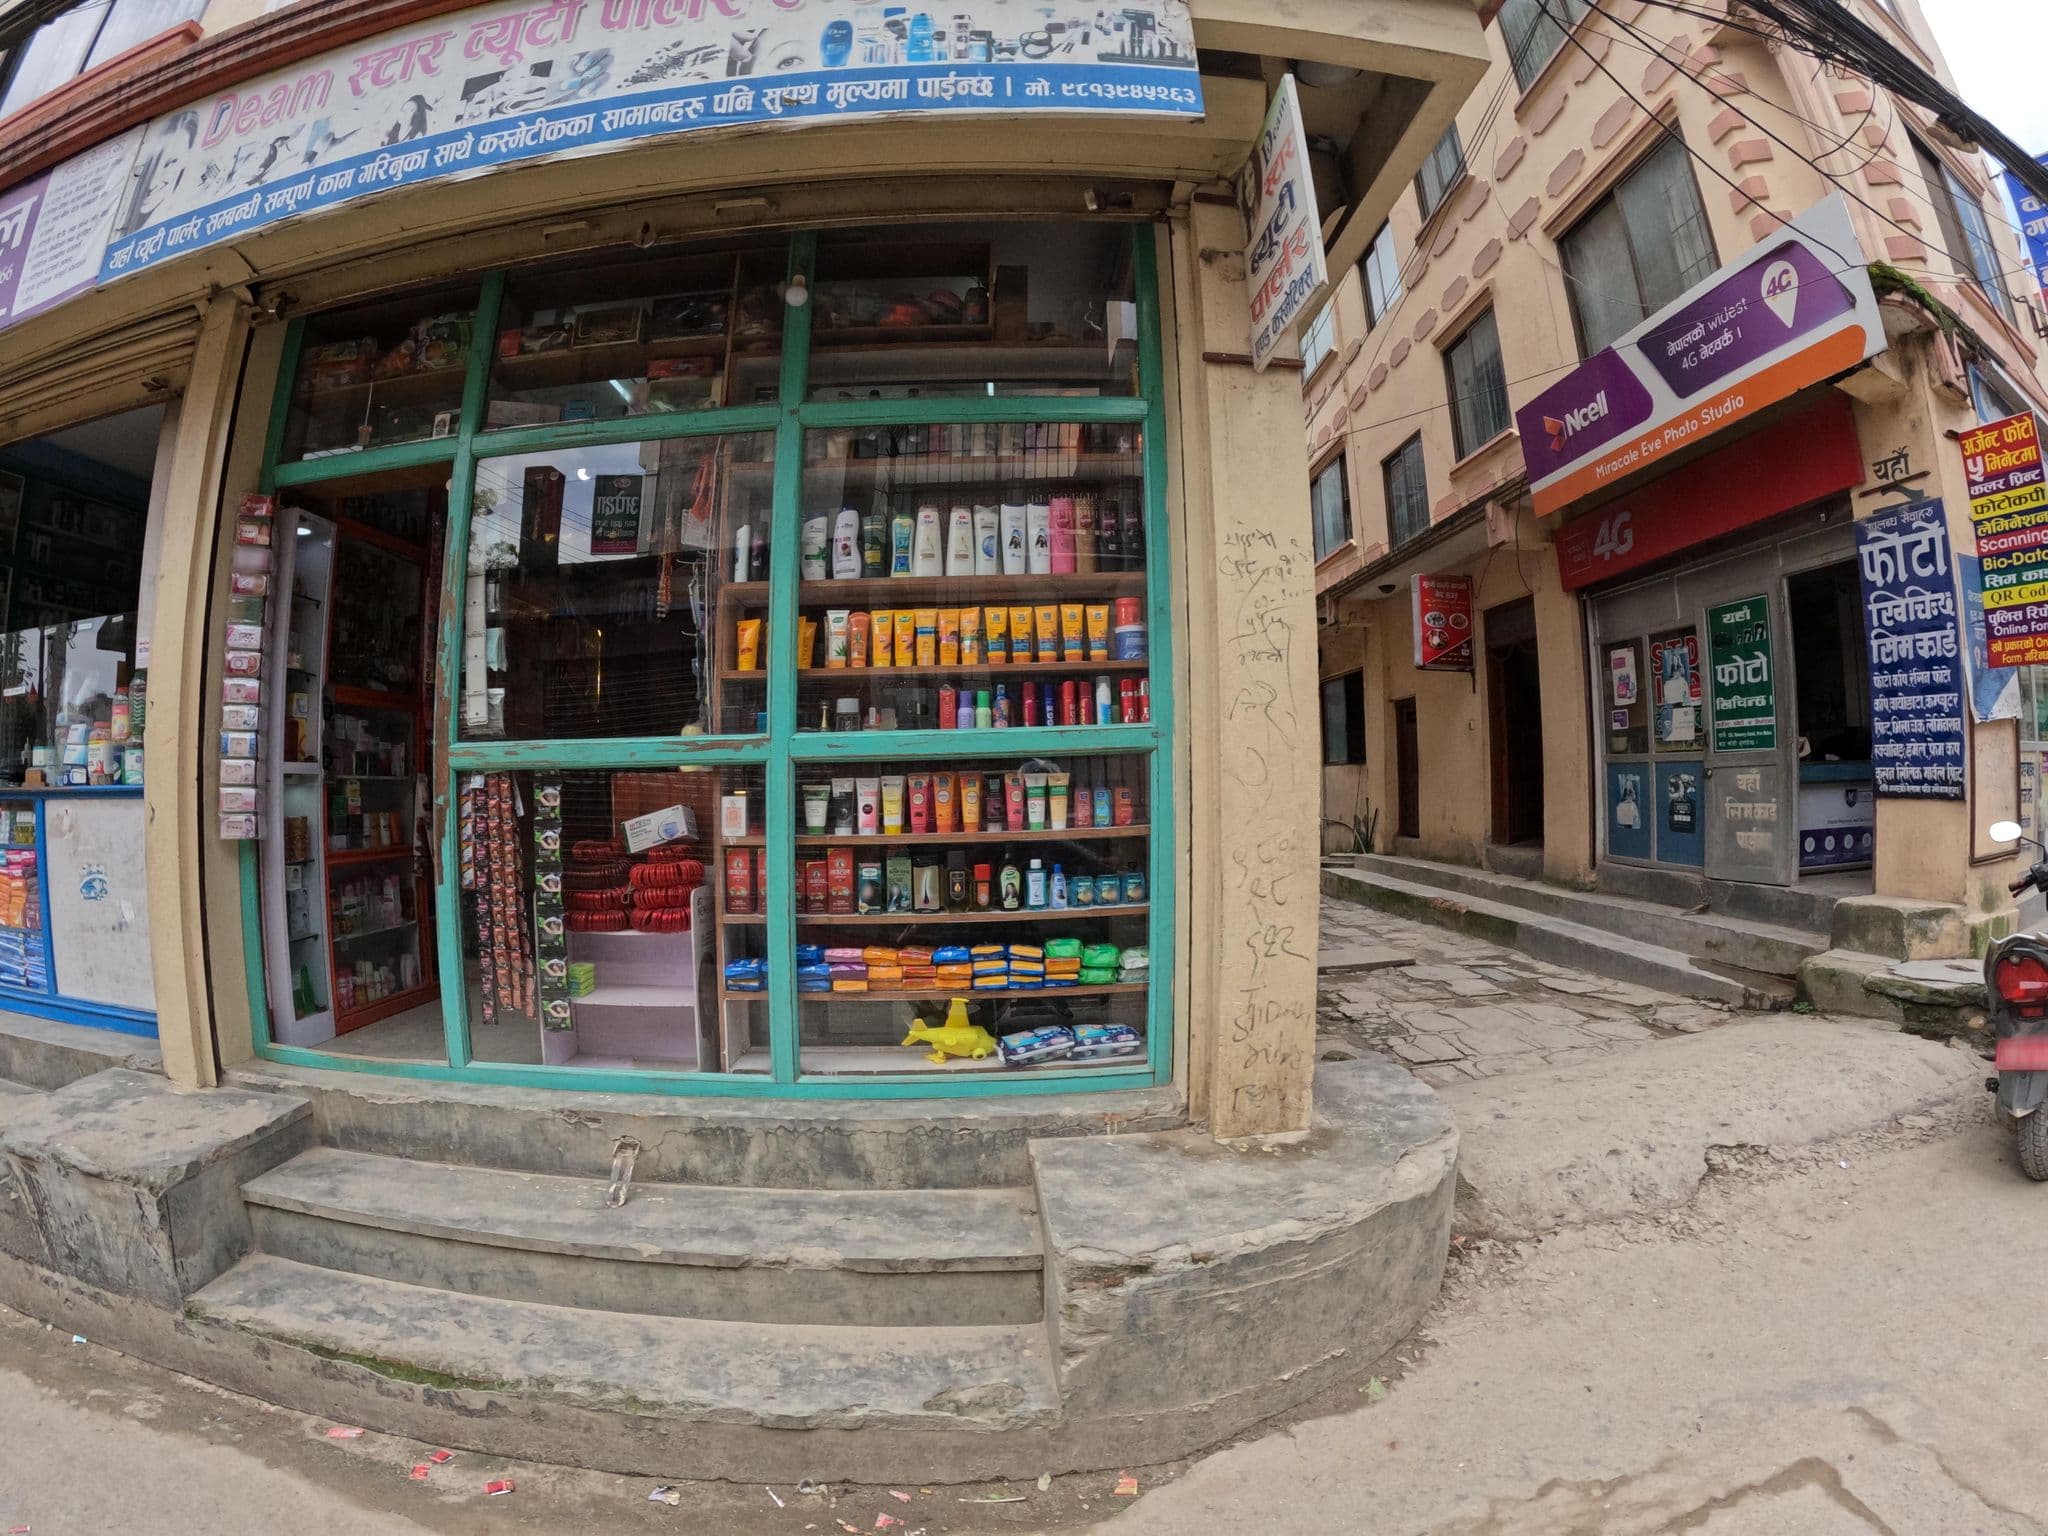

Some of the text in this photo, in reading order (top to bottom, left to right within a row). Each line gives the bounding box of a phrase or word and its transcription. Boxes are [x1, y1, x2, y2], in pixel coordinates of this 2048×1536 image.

[348, 30, 457, 97] स्टार
[167, 216, 205, 246] पार्लर
[264, 175, 316, 214] सम्पूर्ण
[317, 167, 355, 196] काम
[357, 150, 428, 187] गरिनुका
[434, 133, 475, 166] साथै
[478, 113, 597, 155] कस्मेटीकका
[713, 84, 755, 115] पनि
[826, 78, 909, 109] मुल्यमा
[916, 71, 995, 101] पाईन्छ
[1024, 77, 1056, 97] मो.
[1061, 81, 1197, 105] ९८१३९४५२६३
[1766, 268, 1792, 296] 4G
[1667, 297, 1749, 357] नेपालको widest
[1681, 350, 1698, 370] 4G
[1700, 328, 1735, 360] नेटवर्क
[1564, 390, 1610, 437] Ncell
[1664, 418, 1698, 446] Photo
[1701, 393, 1745, 426] Studio
[1962, 416, 2034, 457] अर्जेन्ट फोटो
[1966, 445, 2038, 482] ५ मिनेटमा
[1970, 468, 2042, 496] कलर प्रिन्ट
[1973, 488, 2046, 516] फोटोकपी
[1593, 511, 1634, 561] 4G
[1859, 519, 1948, 588] फोटो
[1985, 573, 2017, 588] सिम
[1990, 588, 2013, 605] QR
[2018, 582, 2048, 600] Cod
[1988, 609, 2023, 627] पुलिस
[1994, 621, 2029, 637] Online
[1715, 650, 1768, 687] फोटो
